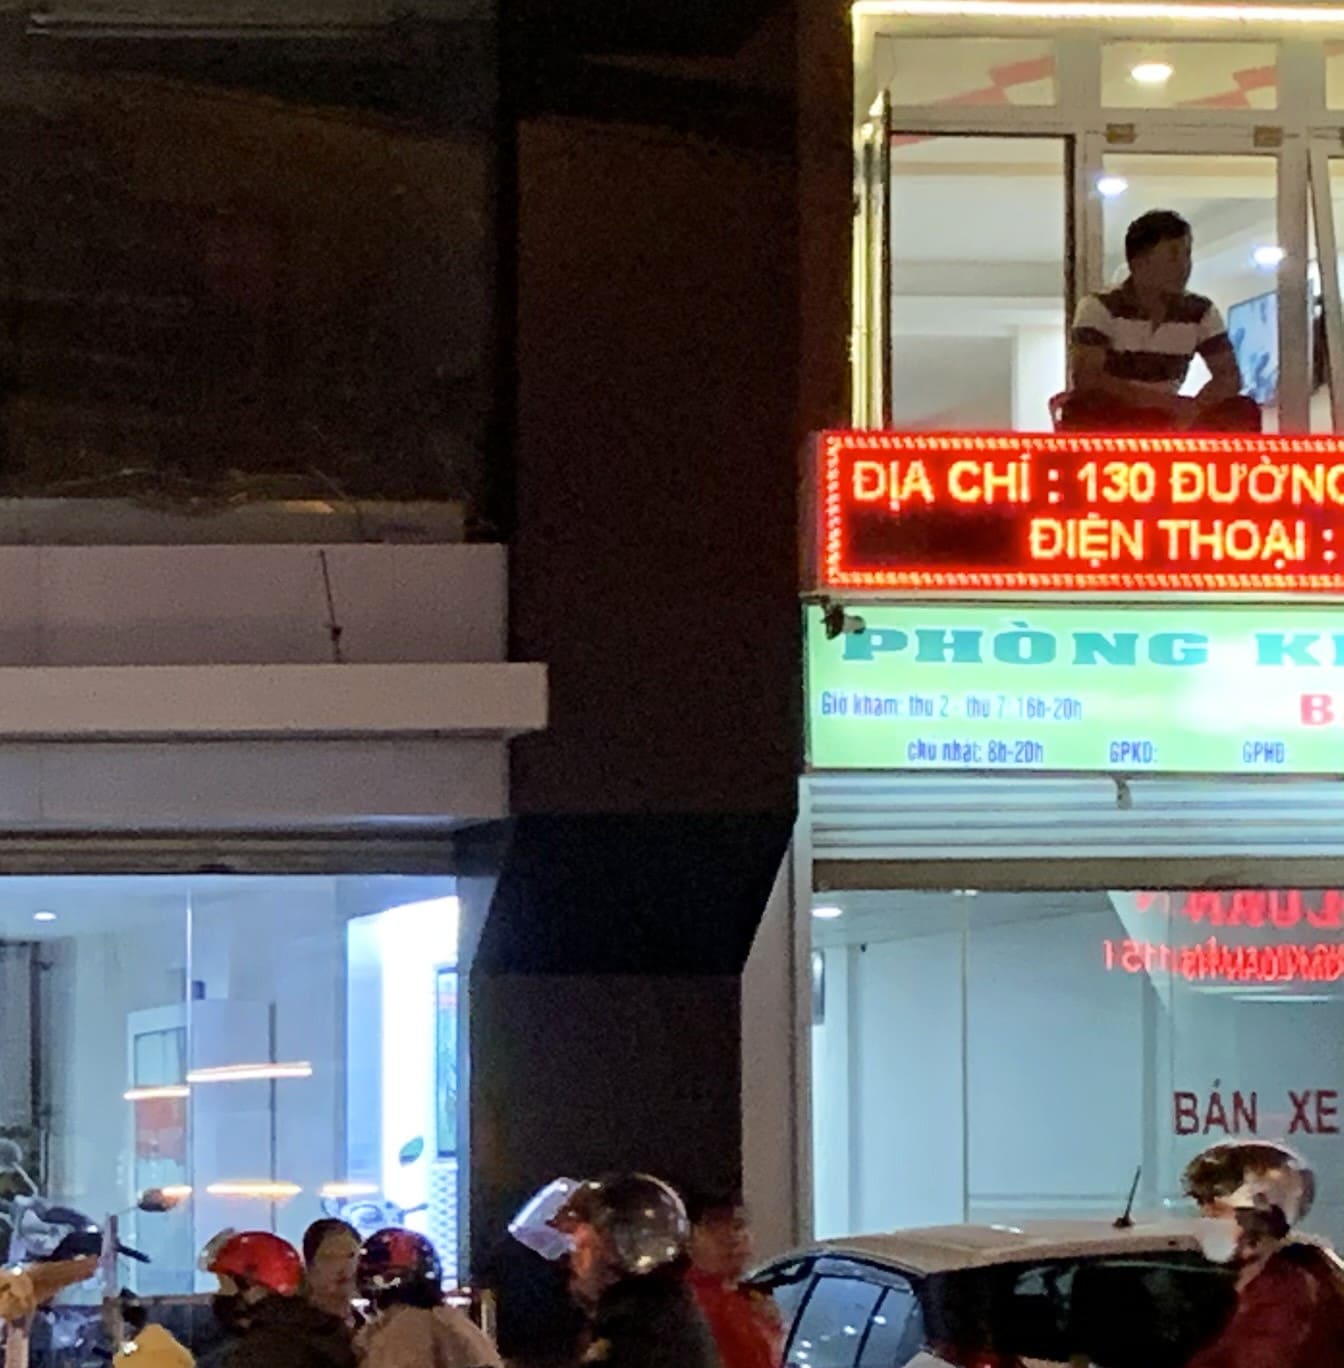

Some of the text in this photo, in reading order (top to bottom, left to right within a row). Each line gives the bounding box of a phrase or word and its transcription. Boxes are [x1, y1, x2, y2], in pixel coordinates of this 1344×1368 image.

[852, 459, 935, 511] ĐỊA
[1077, 461, 1155, 503] 130
[1029, 512, 1144, 568] ĐIỆN
[1157, 518, 1307, 570] THOẠI
[842, 621, 1344, 667] PHÒNG K
[1173, 1078, 1340, 1136] BÁN XE
